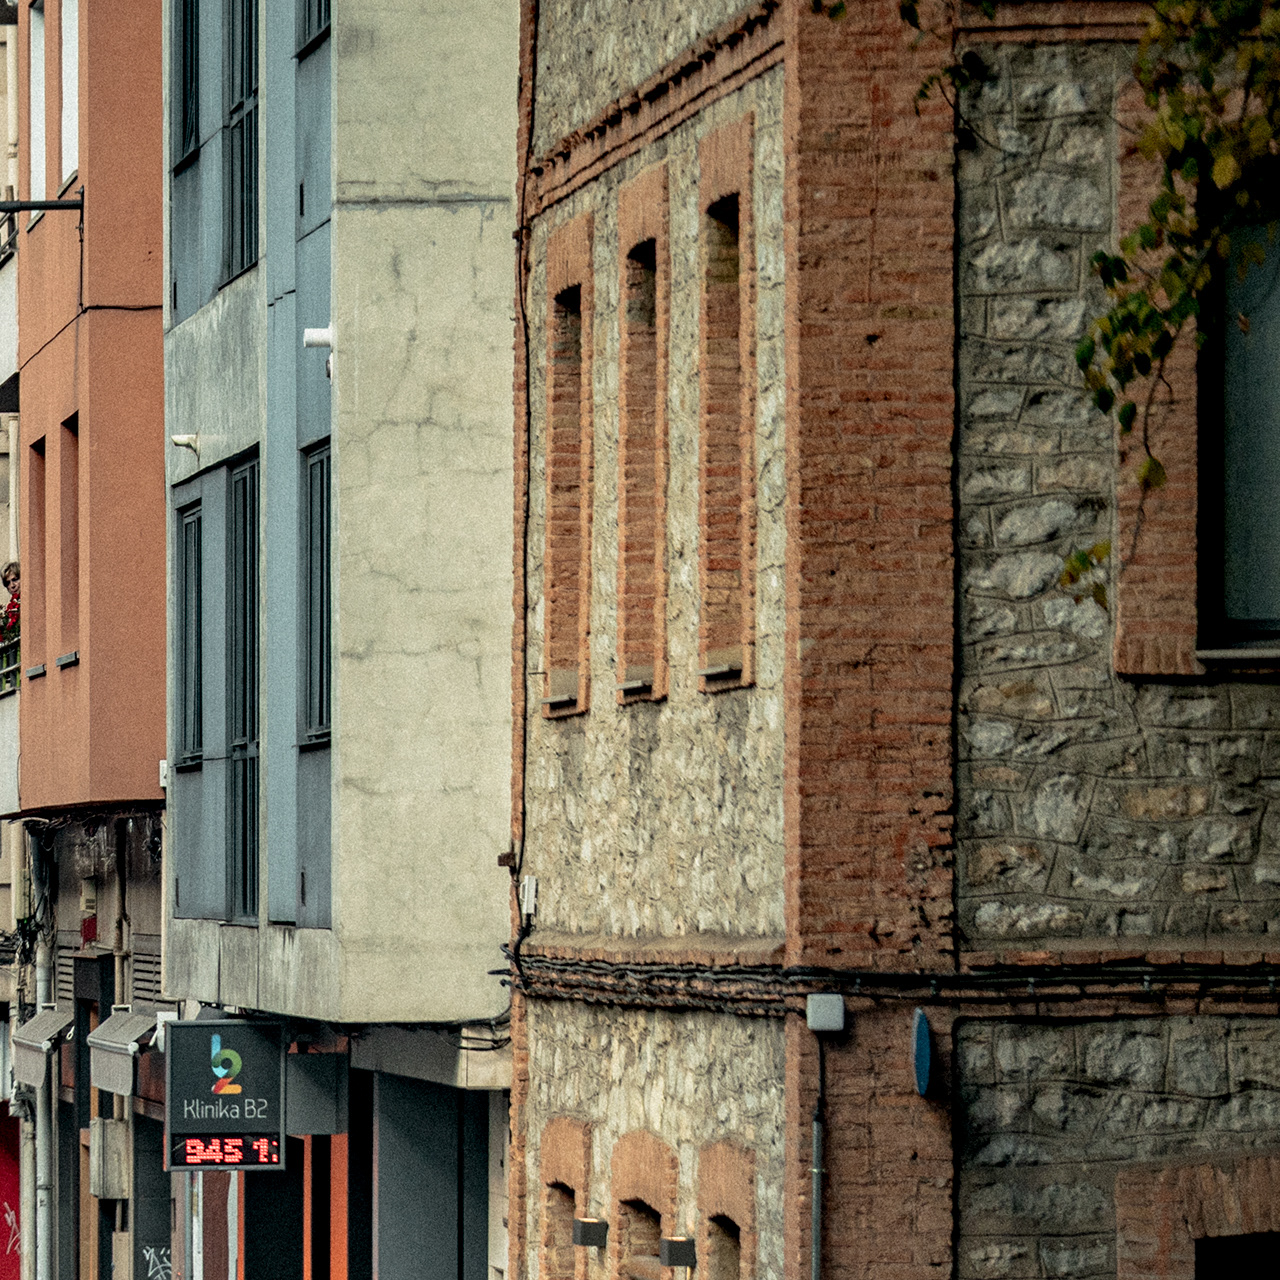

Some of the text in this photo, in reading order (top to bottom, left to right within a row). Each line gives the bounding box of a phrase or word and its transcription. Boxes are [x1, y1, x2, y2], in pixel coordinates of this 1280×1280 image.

[183, 1098, 269, 1119] Klinika B2
[185, 1138, 243, 1163] 945
